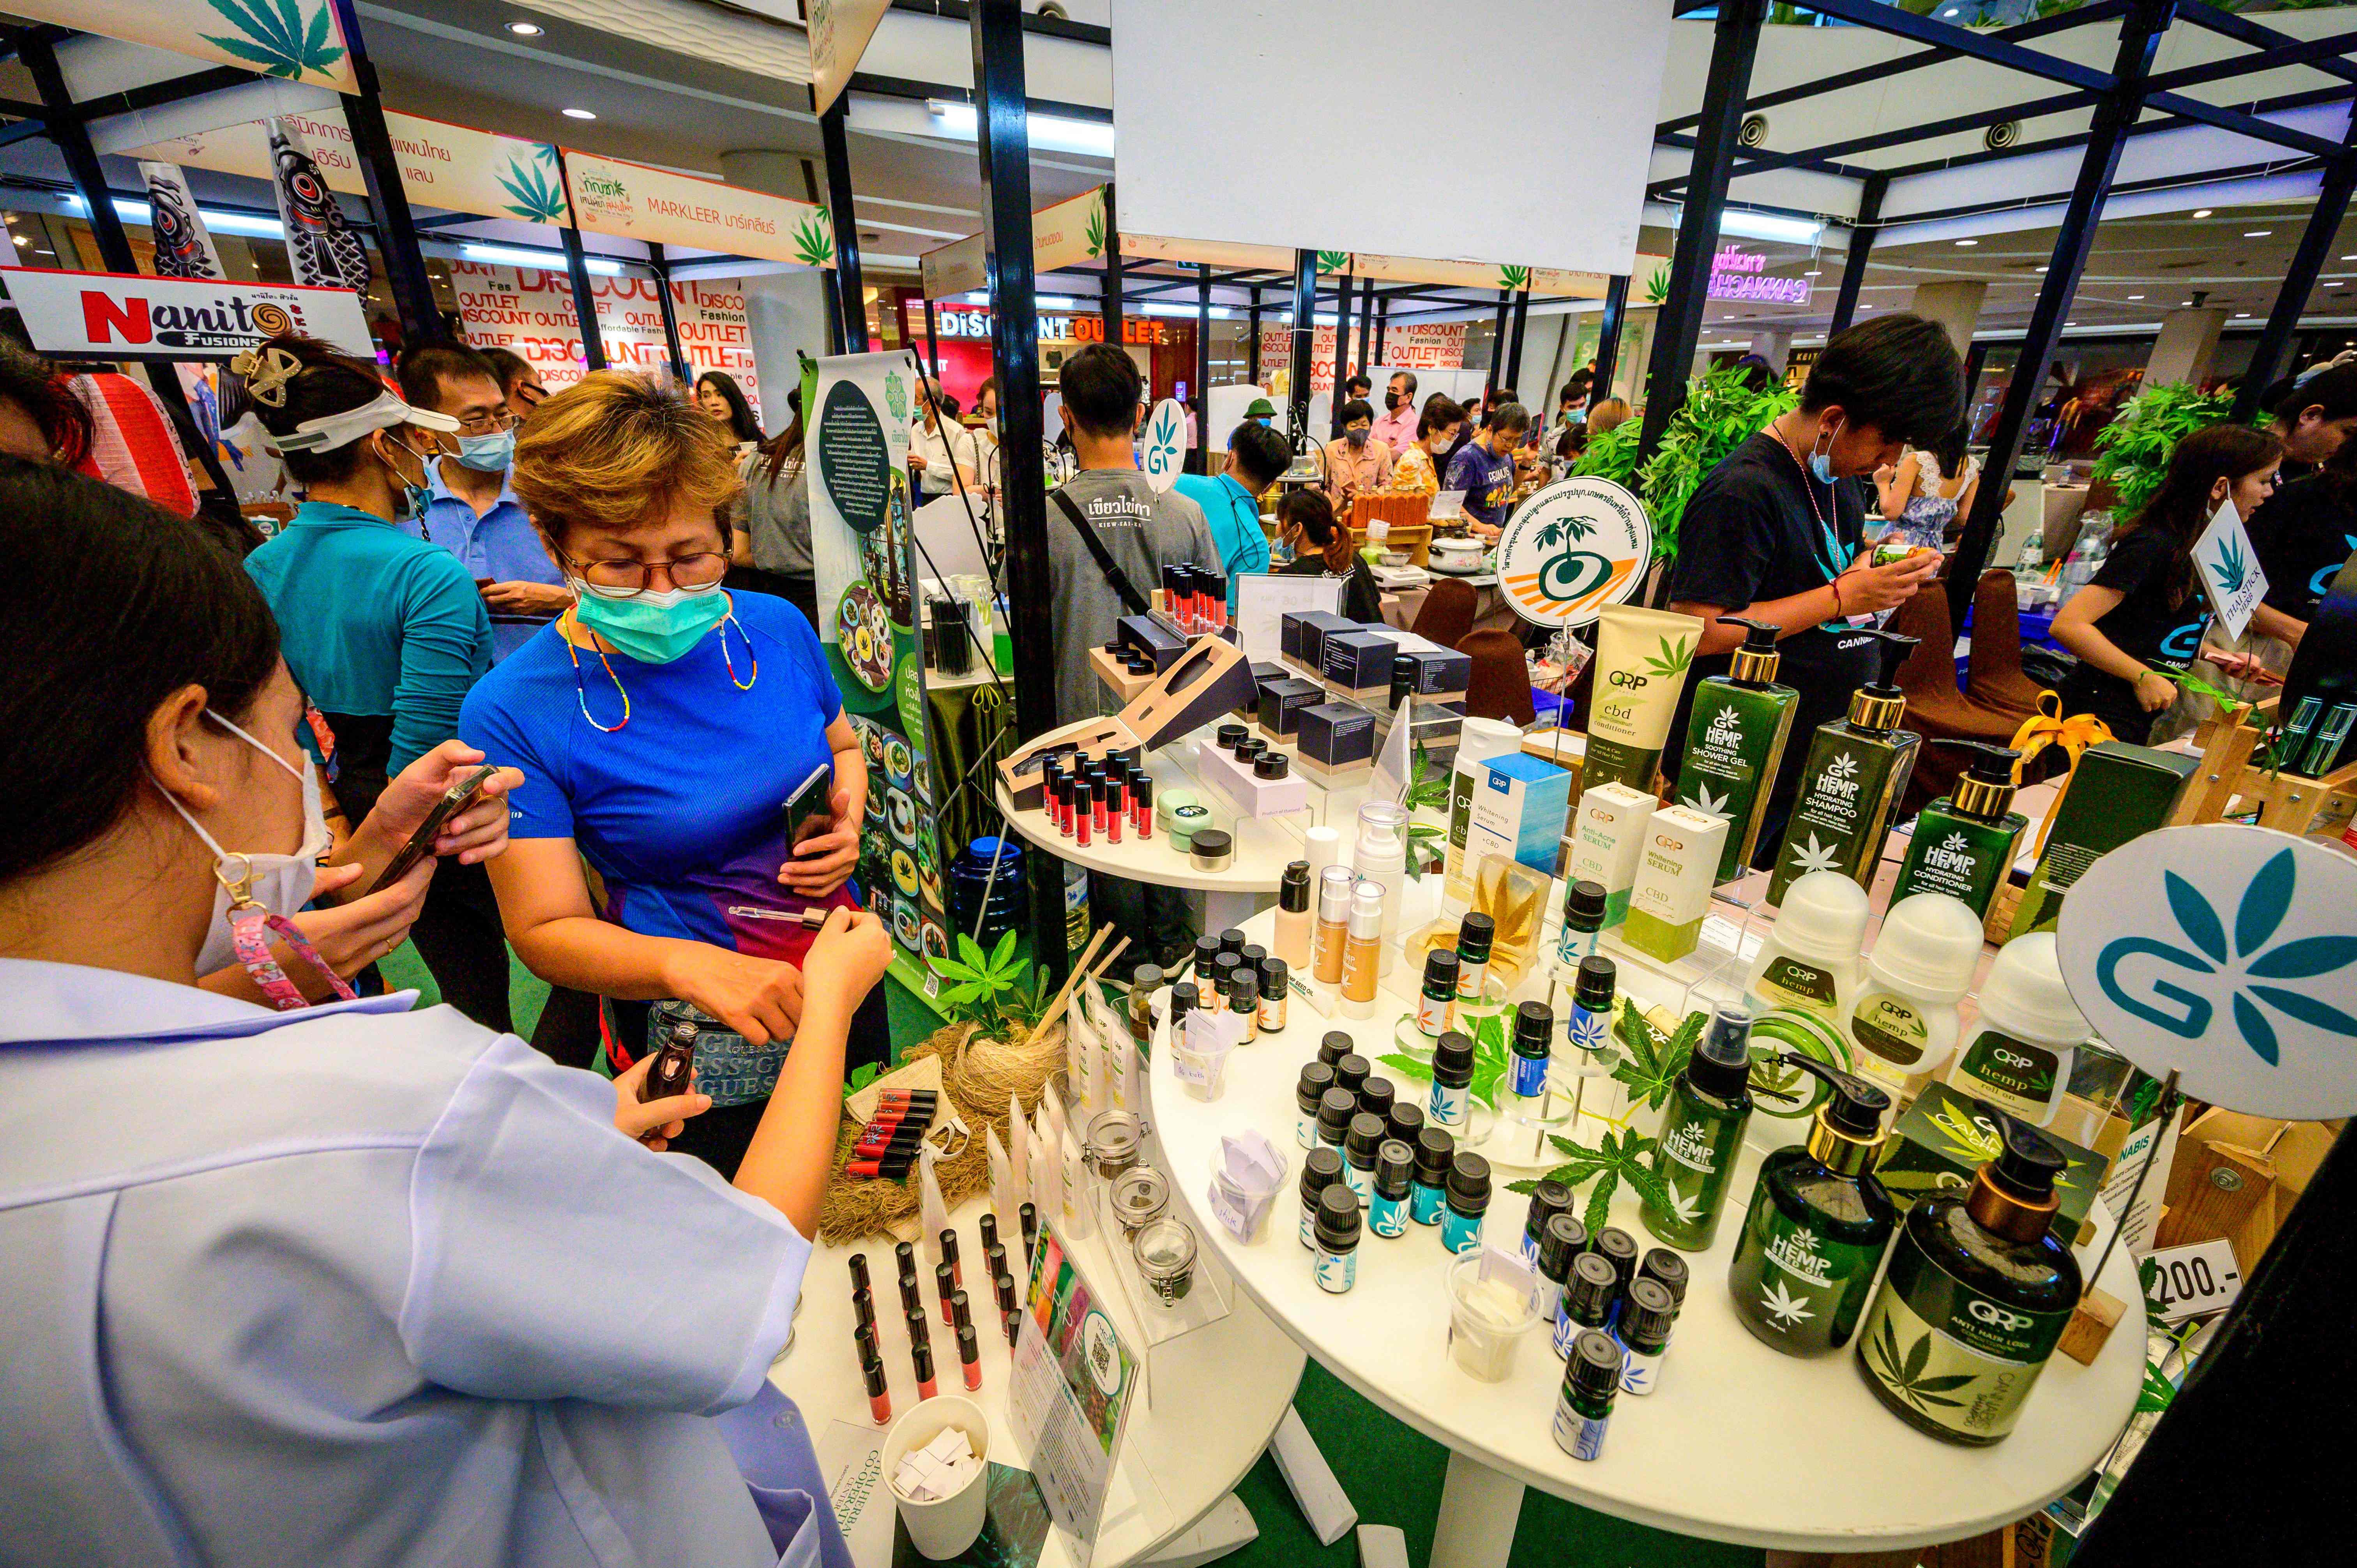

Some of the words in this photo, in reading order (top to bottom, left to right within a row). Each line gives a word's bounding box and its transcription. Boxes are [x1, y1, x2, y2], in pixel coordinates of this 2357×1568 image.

[648, 198, 721, 225] MARKLEER
[459, 292, 520, 309] OUTLET
[535, 312, 580, 328] OUTLE
[700, 310, 745, 322] Fashion
[679, 322, 747, 343] OUTLET
[1074, 318, 1164, 344] OULET
[1412, 324, 1463, 336] DISCOUNT
[1392, 346, 1440, 360] OUTLET
[1088, 495, 1150, 516] เขียวไข่กา
[2226, 594, 2242, 621] THAI
[2241, 566, 2261, 598] STICK
[2239, 592, 2253, 614] HERB
[1604, 705, 1632, 720] cbd
[1594, 720, 1636, 736] conditioner
[1707, 726, 1743, 743] HEMP
[1705, 737, 1724, 746] SEED
[1726, 741, 1740, 749] OIL
[1705, 744, 1737, 756] SOOTHING
[1692, 747, 1729, 763] SHOWER
[1730, 757, 1748, 767] GEL
[1817, 773, 1859, 793] HEMP
[1814, 792, 1853, 808] HYDRATING
[1816, 785, 1838, 795] SEED
[1841, 791, 1855, 801] OIL
[1478, 804, 1509, 824] Whitening
[1806, 797, 1857, 818] SHAMPOO
[1477, 813, 1496, 826] Serum
[1456, 825, 1466, 836] cb
[1582, 825, 1616, 844] Anti-Acne
[1482, 837, 1499, 849] +CBD
[1583, 833, 1612, 851] SERUM
[1582, 858, 1603, 872] CBD
[1648, 850, 1683, 870] Whitening
[1924, 857, 1950, 869] SEED
[1953, 866, 1972, 876] OIL
[1926, 846, 1976, 868] HEMP
[1647, 858, 1682, 877] SERUM
[1925, 866, 1965, 882] HYDRATING
[1913, 870, 1973, 892] CONDITIONER
[1645, 887, 1669, 902] CBD
[1945, 888, 1960, 896] types
[1295, 980, 1306, 991] SEED
[1781, 976, 1815, 995] hemp
[1783, 989, 1797, 998] roll
[1097, 1029, 1107, 1041] CBD
[1873, 1015, 1908, 1037] hemp
[1980, 1064, 2028, 1091] hemp
[1981, 1083, 1999, 1095] roll
[2002, 1091, 2016, 1102] on
[1668, 1128, 1715, 1159] HEMP
[1668, 1139, 1690, 1158] SEED
[1694, 1156, 1710, 1165] OIL
[1773, 1234, 1832, 1272] HEMP
[1771, 1247, 1799, 1268] SEED
[1805, 1266, 1826, 1279] OIL
[1061, 1382, 1085, 1429] TERPENE
